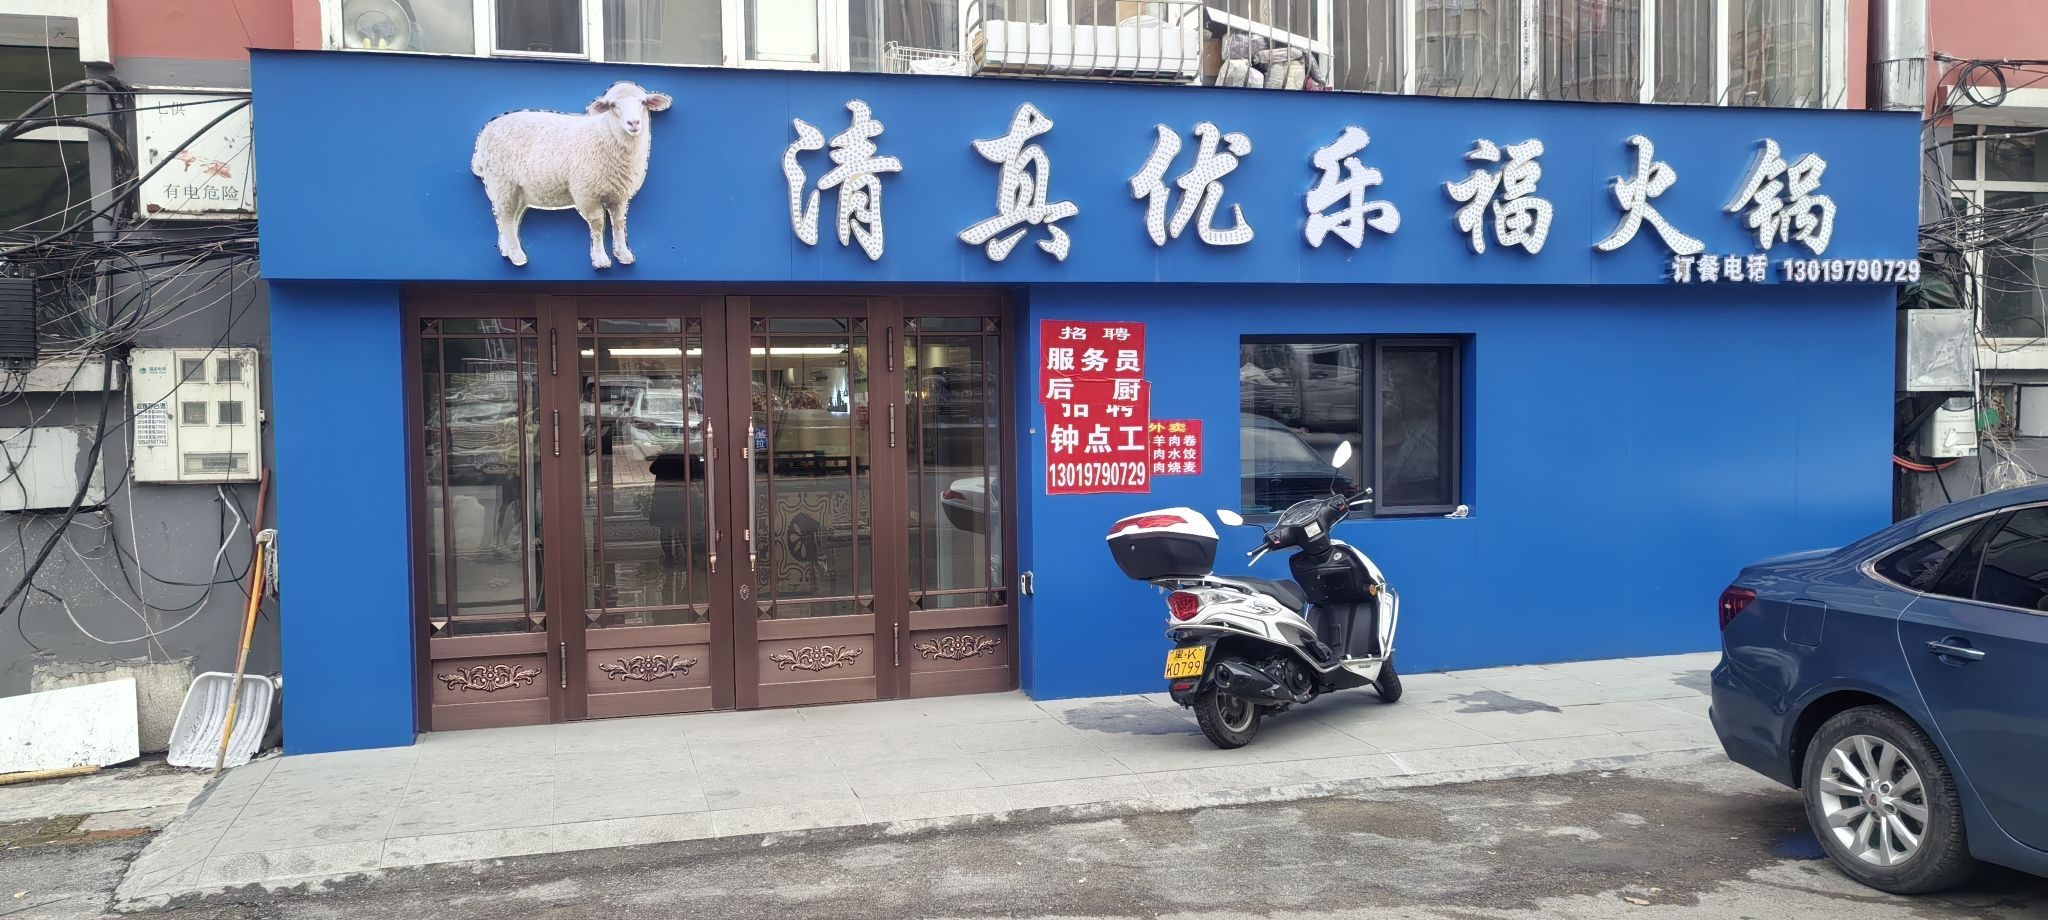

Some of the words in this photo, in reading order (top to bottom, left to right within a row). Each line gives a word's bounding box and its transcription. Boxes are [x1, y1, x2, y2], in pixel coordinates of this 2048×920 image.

[163, 183, 240, 201] 有电危险
[783, 98, 1839, 262] 清真优乐福火锅
[1671, 253, 1767, 283] 订餐电话
[1783, 257, 1921, 283] 13019790729
[1058, 326, 1131, 341] 招聘
[1046, 347, 1141, 372] 服务员
[1045, 377, 1142, 402] 后厨
[1050, 423, 1146, 454] 钟点工
[1149, 422, 1187, 433] 外卖
[1049, 461, 1146, 487] 13019790729
[1166, 661, 1201, 677] K0799
